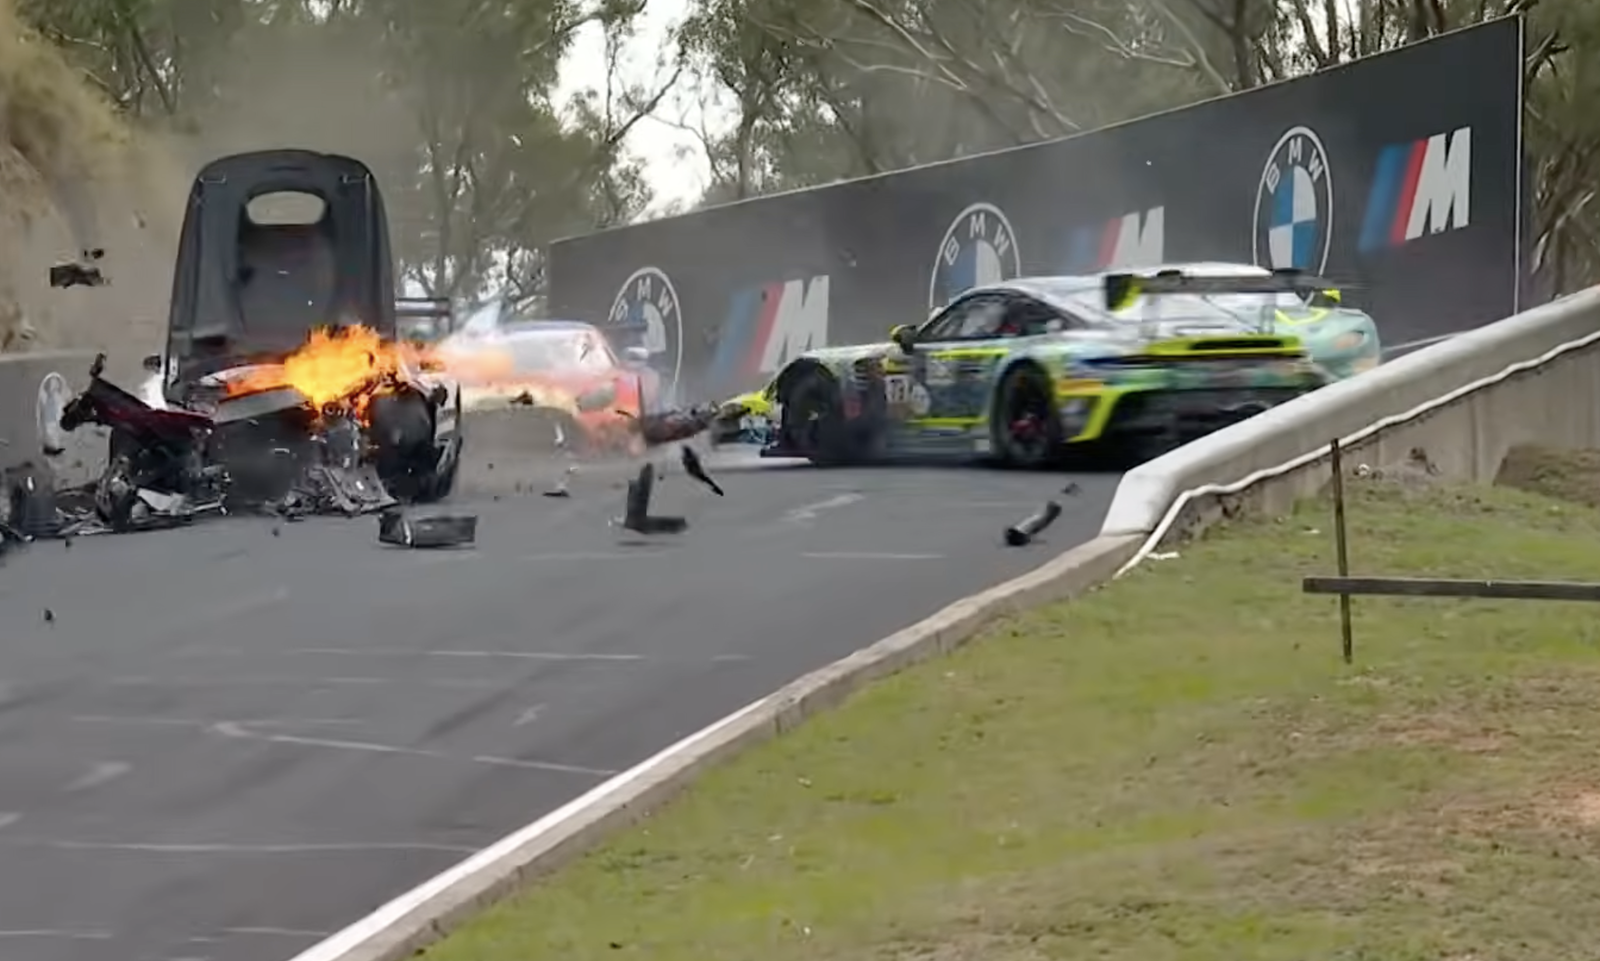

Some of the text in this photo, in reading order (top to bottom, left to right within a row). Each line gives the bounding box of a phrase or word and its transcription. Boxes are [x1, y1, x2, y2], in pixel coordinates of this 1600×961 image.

[1266, 136, 1323, 195] BMW
[1405, 126, 1470, 241] M
[945, 211, 1010, 266] BMW
[1111, 205, 1164, 267] M
[759, 275, 829, 373] M
